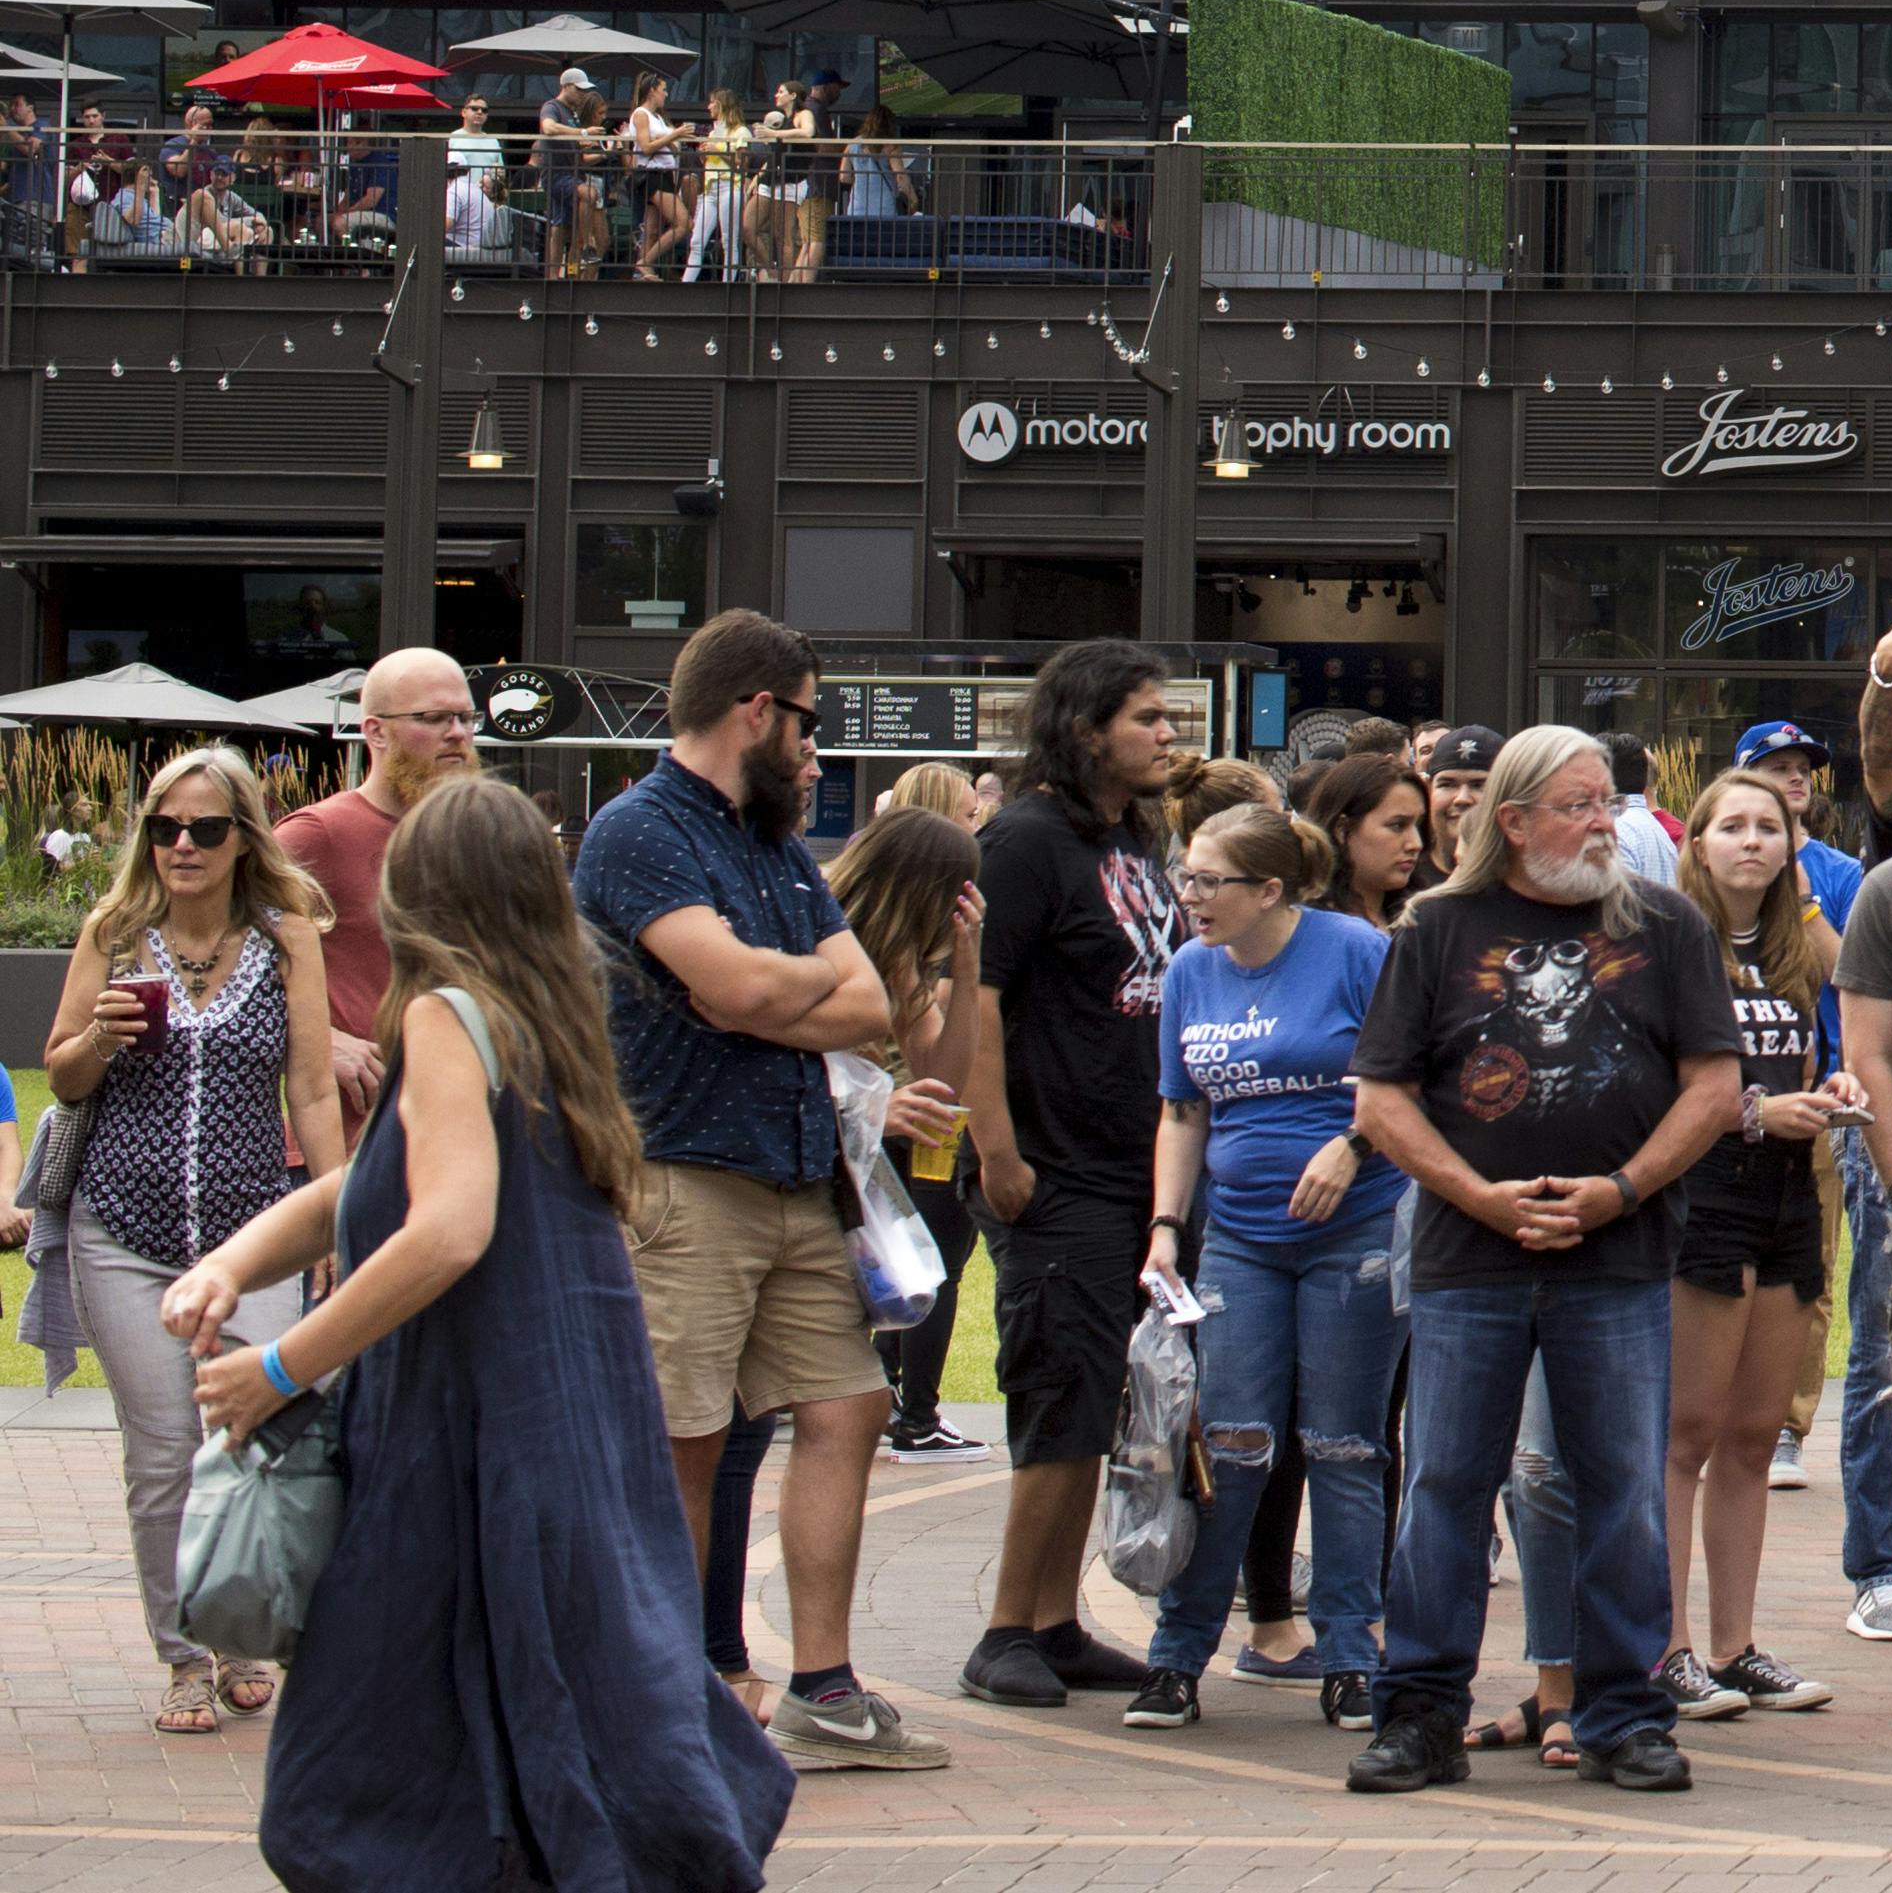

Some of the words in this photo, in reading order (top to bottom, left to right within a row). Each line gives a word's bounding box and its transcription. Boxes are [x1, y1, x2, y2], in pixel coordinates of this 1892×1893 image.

[1452, 28, 1483, 47] EXIT
[1212, 415, 1336, 455] tophy
[1348, 422, 1450, 449] room
[1661, 389, 1858, 477] Jostens
[1680, 557, 1855, 650] Jostens
[500, 673, 545, 689] GOOSE
[498, 716, 545, 734] ISLAND
[1733, 999, 1799, 1023] THE
[1742, 1029, 1815, 1056] REA
[1194, 1059, 1261, 1085] GOOD
